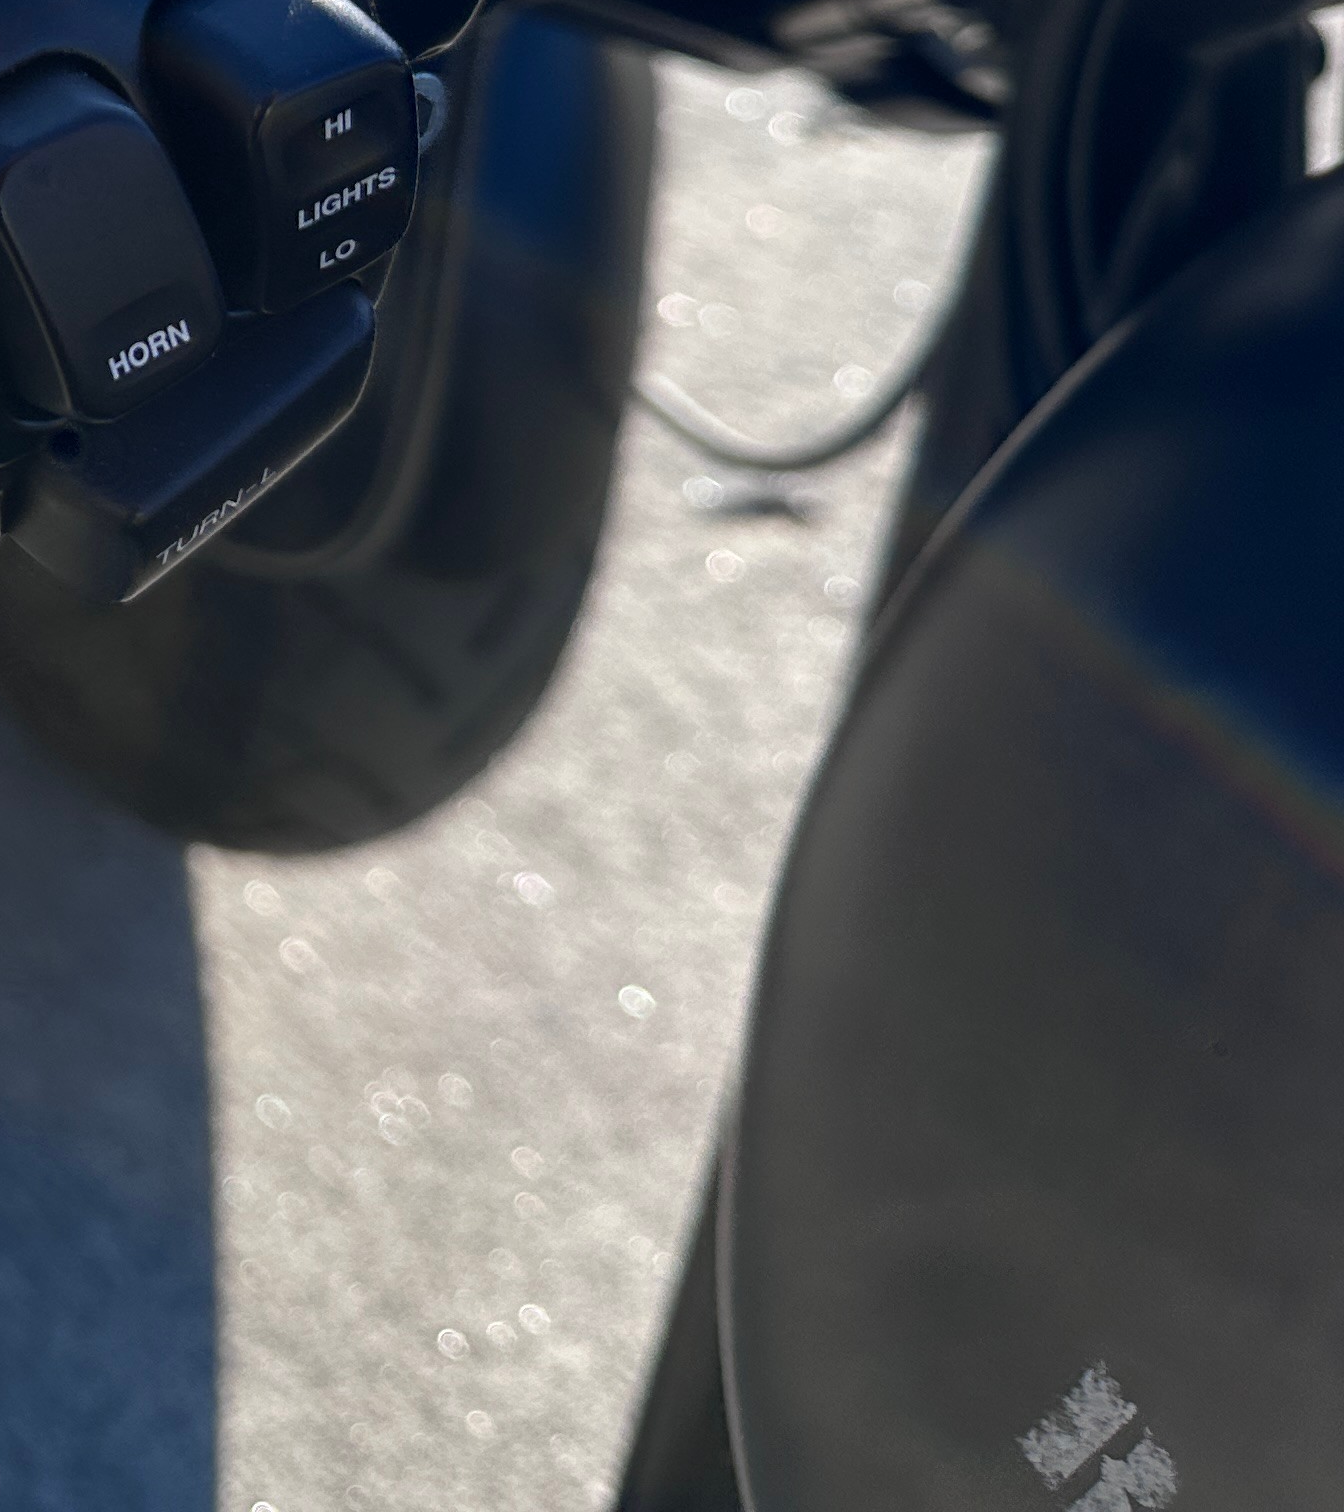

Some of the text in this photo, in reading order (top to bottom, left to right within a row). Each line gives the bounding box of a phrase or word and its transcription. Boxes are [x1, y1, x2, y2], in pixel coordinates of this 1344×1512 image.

[324, 108, 353, 142] HI
[297, 165, 398, 231] LIGHTS
[319, 238, 357, 270] LO
[108, 319, 192, 380] HORN
